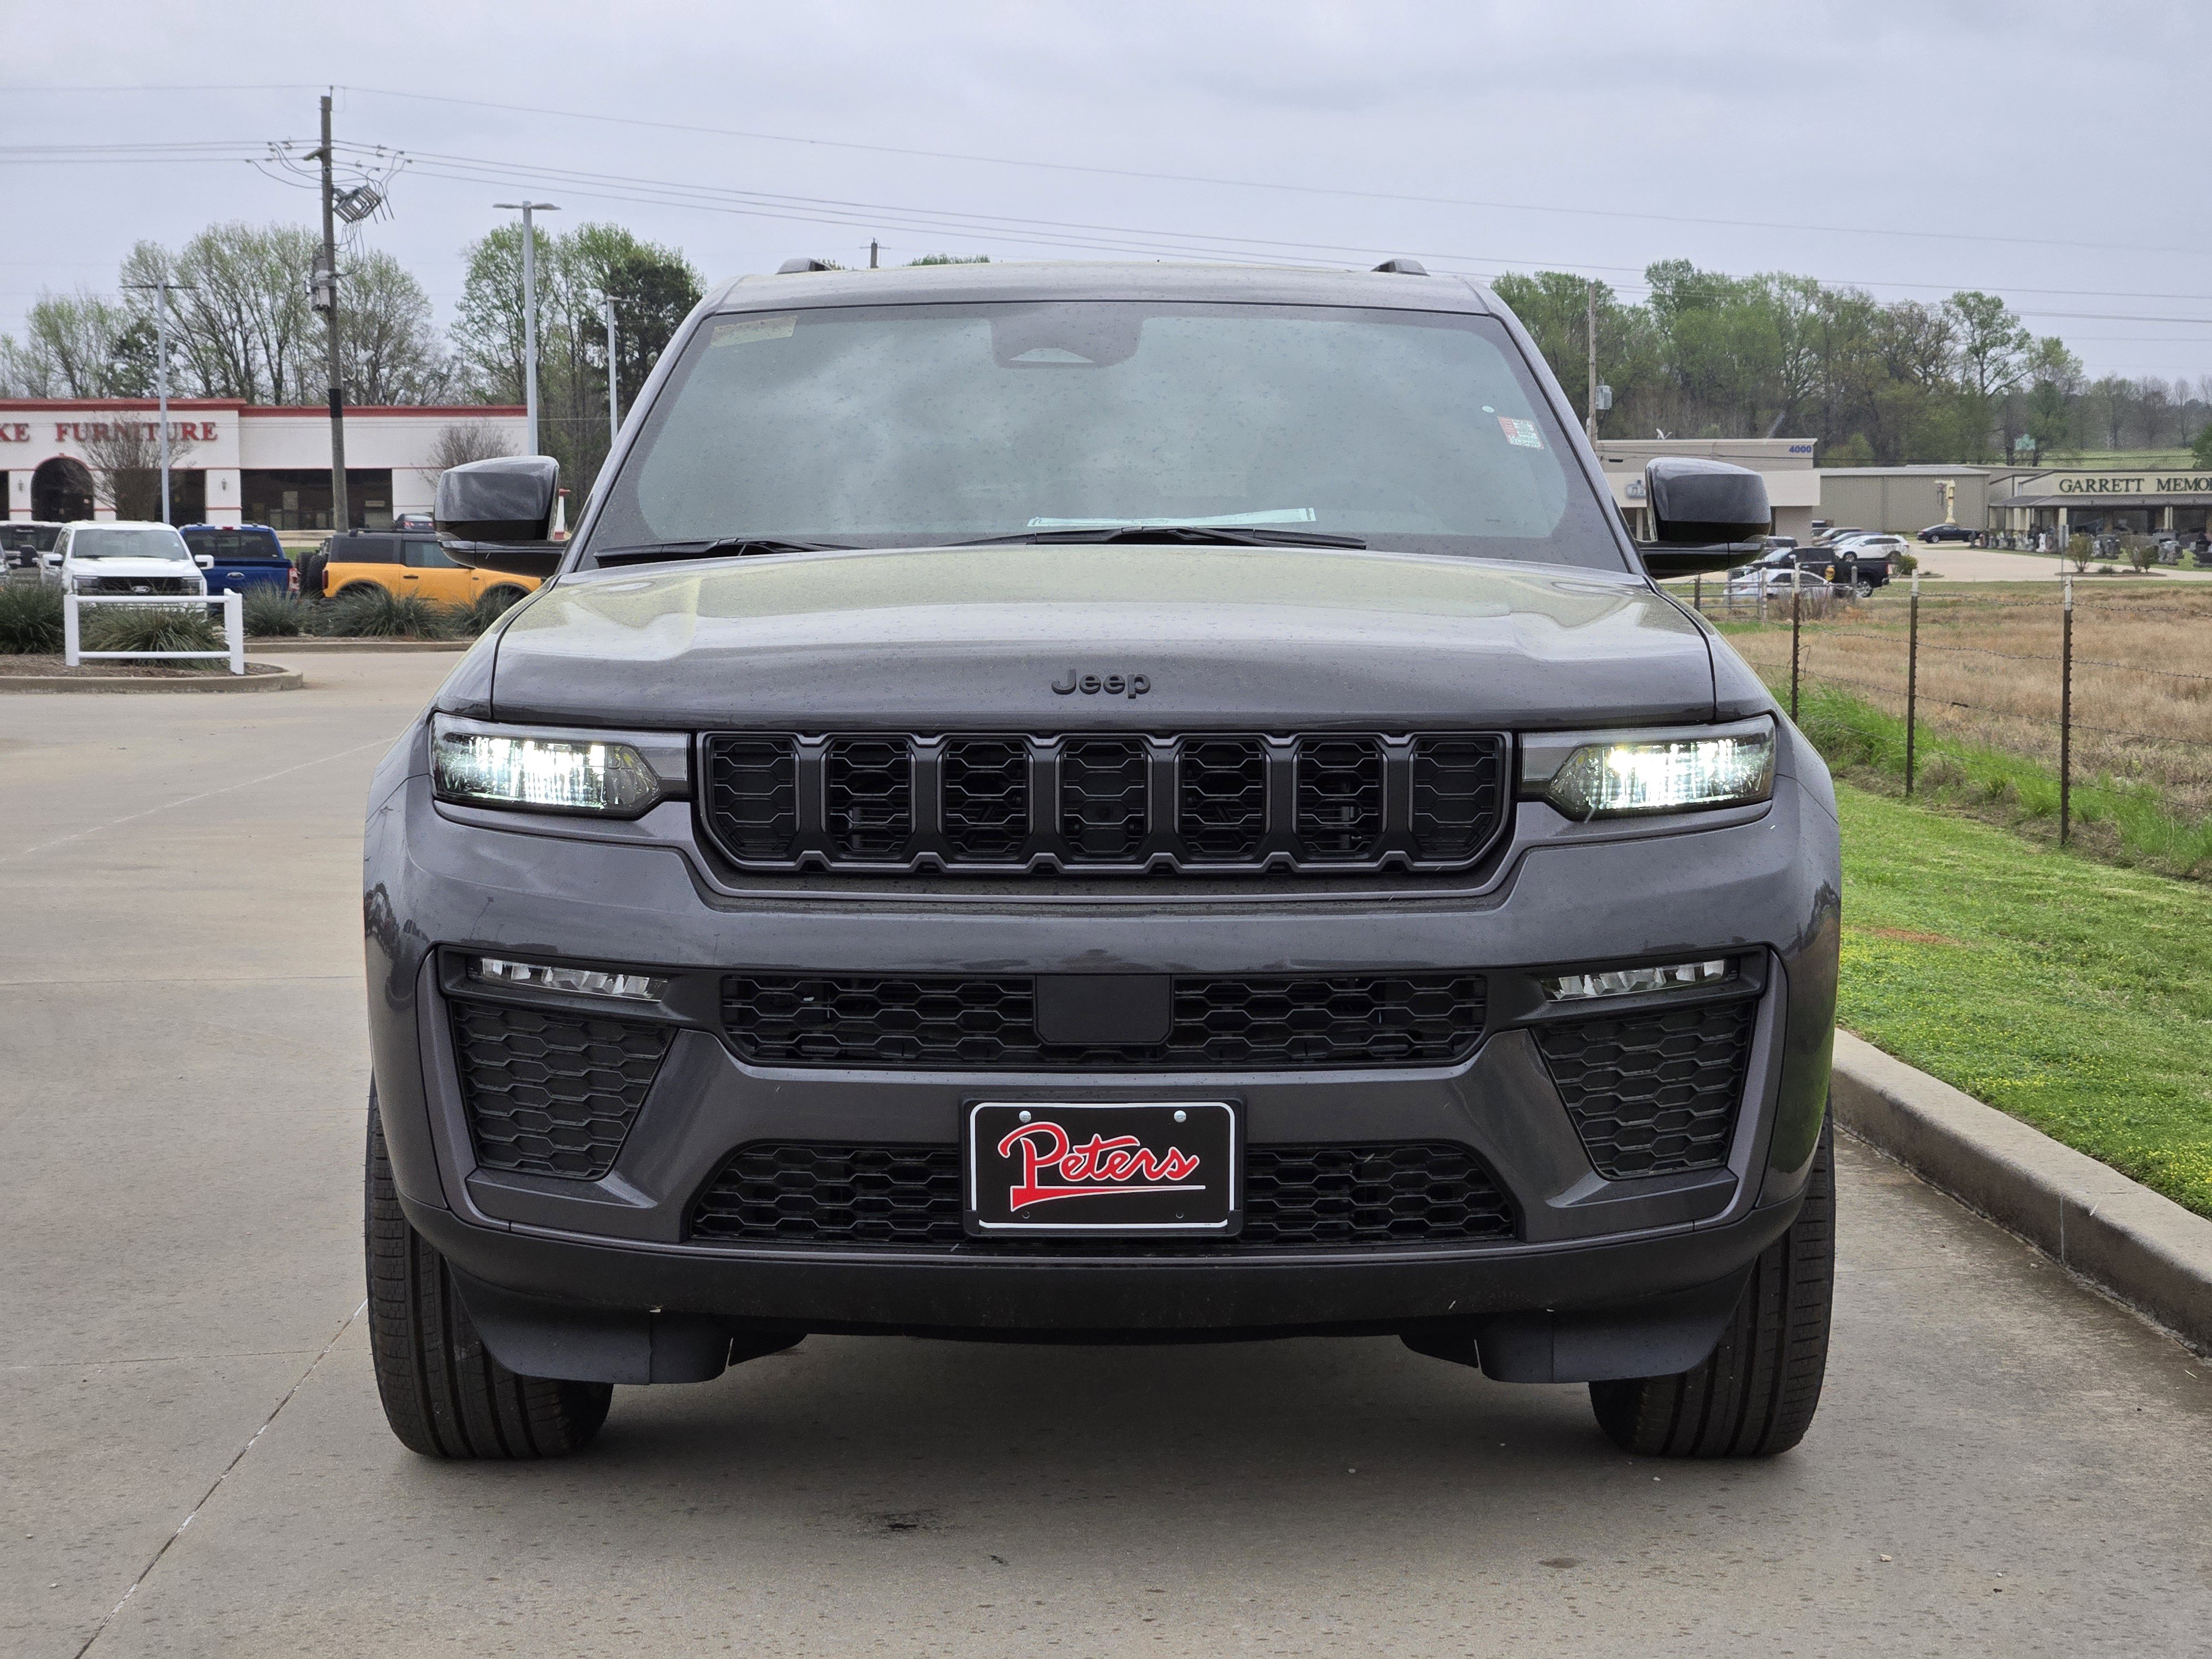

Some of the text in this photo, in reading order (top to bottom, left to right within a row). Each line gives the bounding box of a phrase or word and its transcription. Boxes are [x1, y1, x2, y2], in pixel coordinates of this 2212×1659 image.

[55, 421, 218, 442] FURNITURE
[2059, 478, 2145, 493] GARRETT
[1051, 669, 1151, 699] Jeep
[998, 1121, 1206, 1211] Peters
